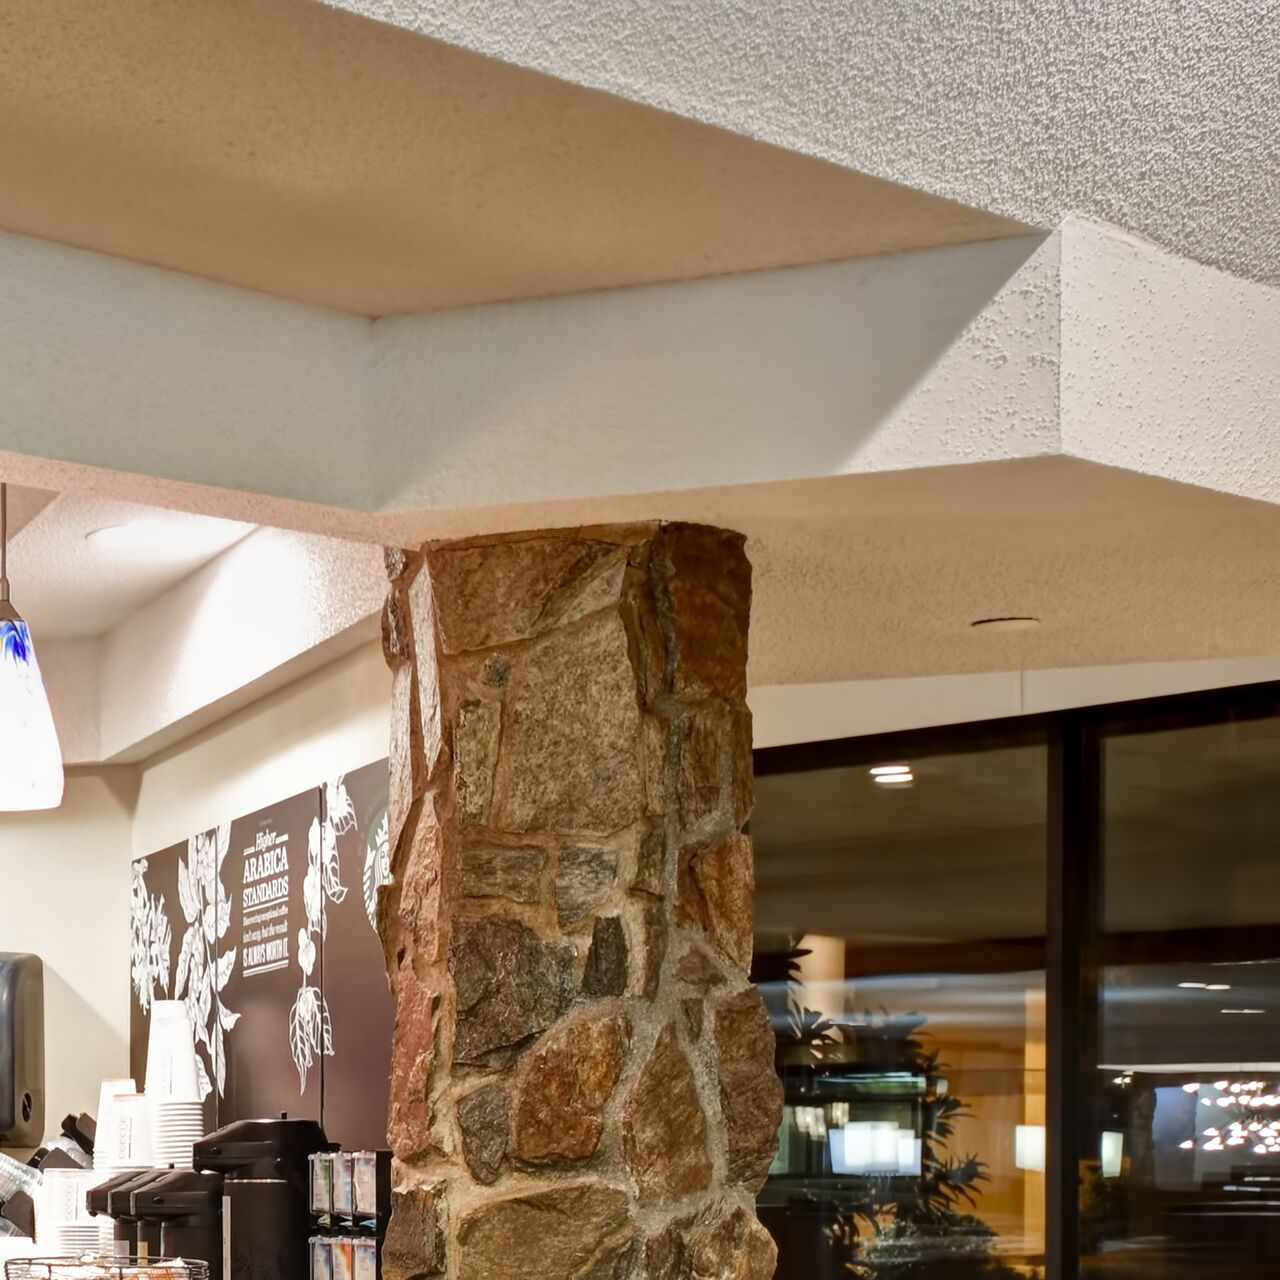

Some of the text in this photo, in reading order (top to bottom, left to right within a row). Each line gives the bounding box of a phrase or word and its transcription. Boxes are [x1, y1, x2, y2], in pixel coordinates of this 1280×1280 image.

[255, 828, 277, 851] Higher
[243, 845, 289, 884] ARABICA
[243, 875, 289, 908] STANDARDS
